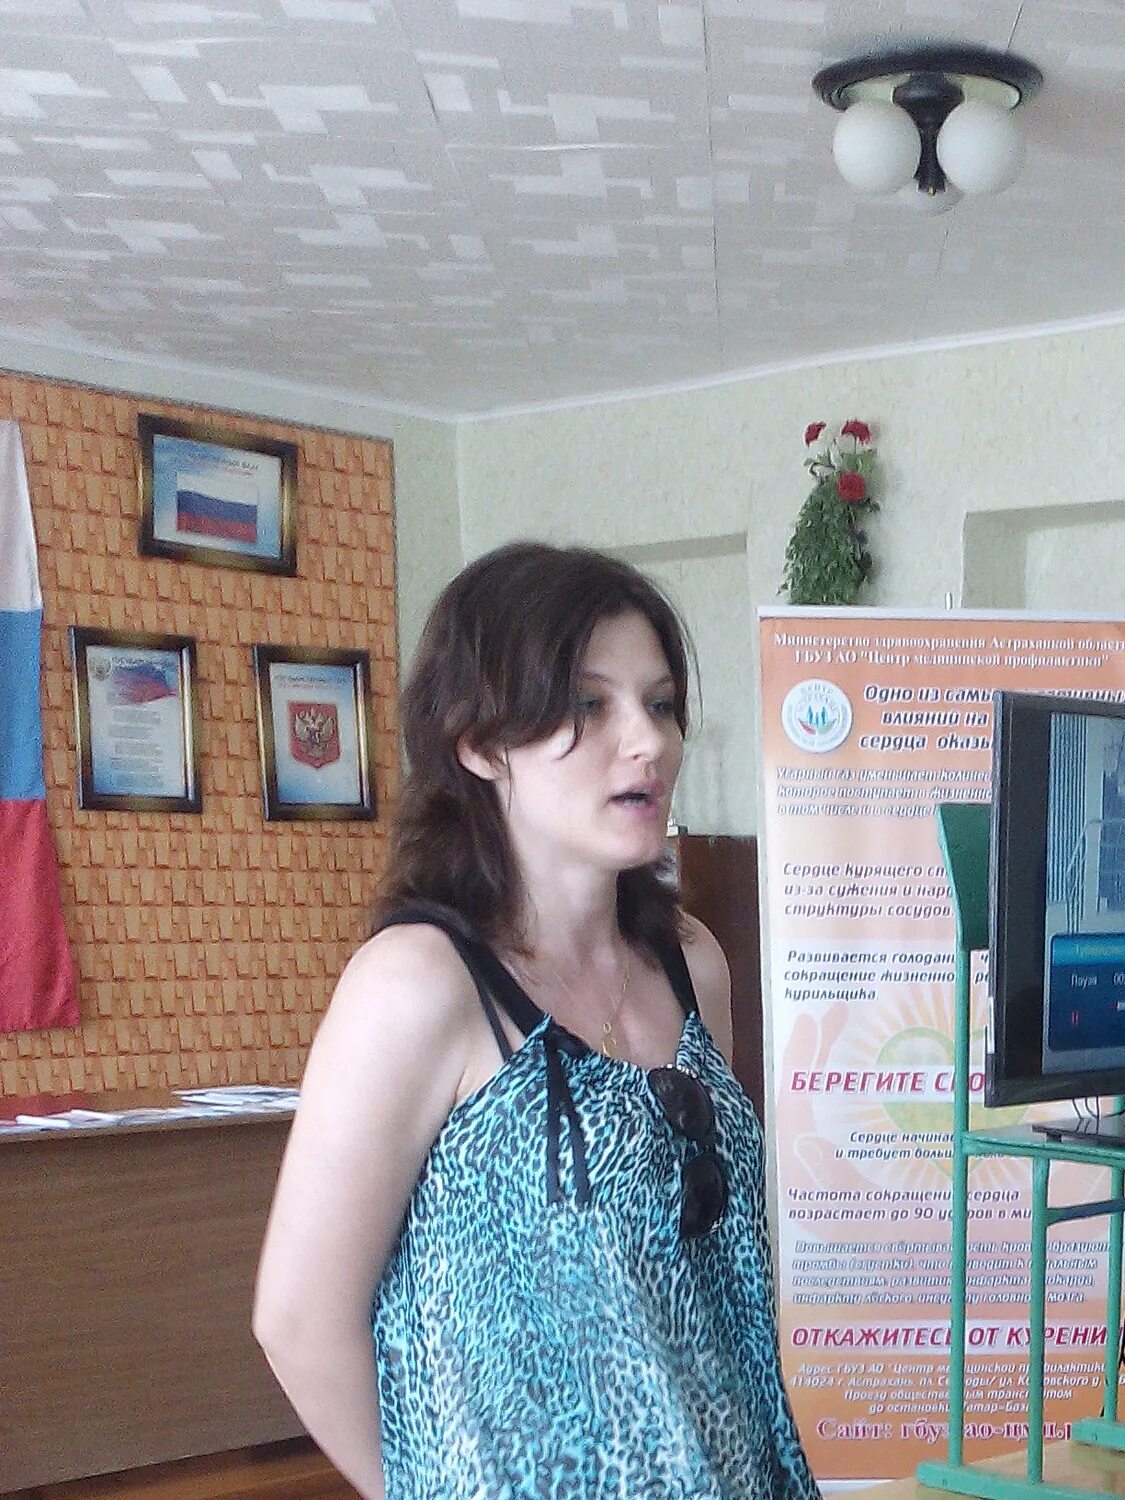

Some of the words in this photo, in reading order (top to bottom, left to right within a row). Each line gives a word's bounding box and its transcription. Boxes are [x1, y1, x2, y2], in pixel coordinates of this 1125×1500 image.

[774, 633, 870, 650] Министерство
[864, 685, 914, 703] Одно
[918, 686, 940, 702] из
[944, 688, 995, 702] самы
[882, 708, 960, 726] влияний
[964, 710, 989, 726] на
[860, 733, 928, 751] сердца
[937, 732, 994, 750] оказы
[940, 768, 992, 781] количес
[783, 862, 840, 878] Сердце
[845, 862, 923, 879] курящего
[927, 864, 948, 878] сп
[784, 884, 824, 897] из-за
[829, 883, 898, 898] сужения
[903, 885, 913, 897] и
[785, 902, 883, 918] структуры
[787, 950, 888, 964] Развивается
[892, 952, 956, 967] голодан
[784, 969, 877, 983] сокращение
[881, 968, 956, 983] жизненно
[791, 1071, 925, 1094] БЕРЕГИТЕ
[934, 1072, 986, 1094] СО
[850, 1131, 898, 1145] Сердце
[902, 1133, 955, 1144] начина
[836, 1150, 843, 1160] и
[848, 1148, 911, 1161] требует
[788, 1188, 861, 1201] Частота
[865, 1188, 952, 1202] сокращени
[789, 1208, 886, 1221] возрастает
[891, 1209, 907, 1222] до
[914, 1207, 933, 1219] 90
[937, 1209, 993, 1222] уров
[998, 1210, 1005, 1220] в
[1011, 1210, 1033, 1221] ми
[968, 1327, 1000, 1346] ОТ
[1006, 1327, 1124, 1346] КРЕНИ
[817, 1416, 893, 1440] Сайт:
